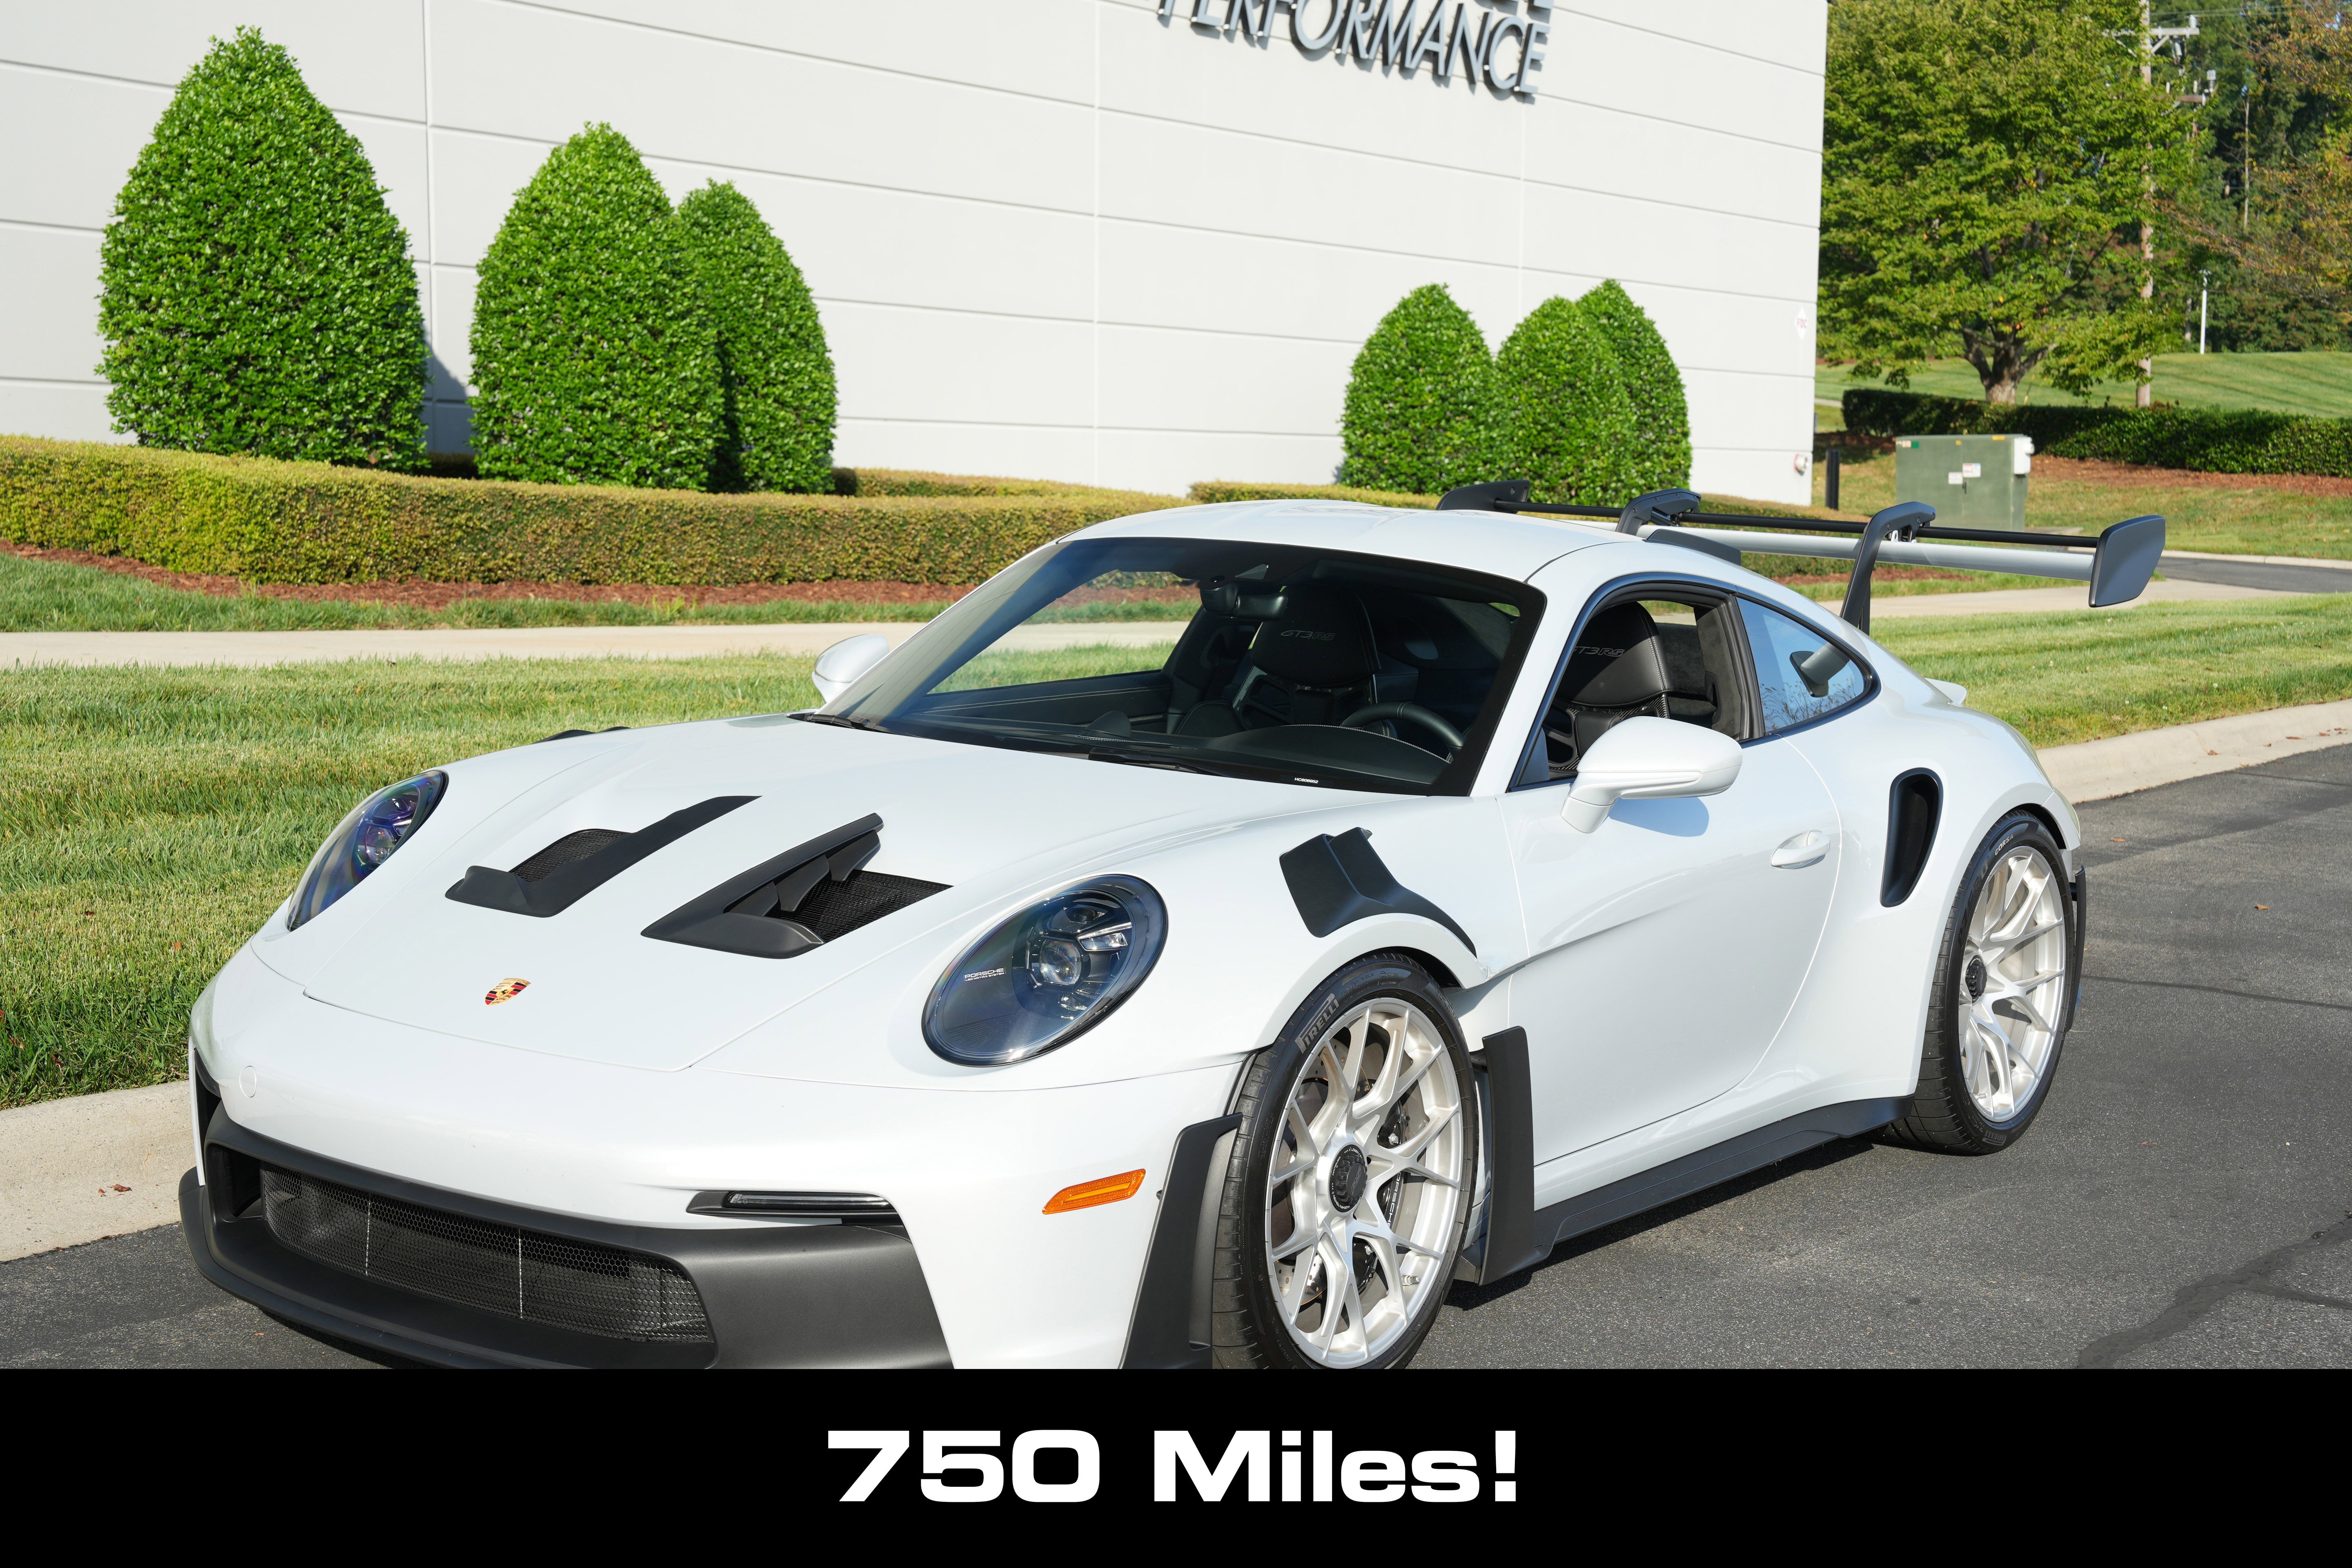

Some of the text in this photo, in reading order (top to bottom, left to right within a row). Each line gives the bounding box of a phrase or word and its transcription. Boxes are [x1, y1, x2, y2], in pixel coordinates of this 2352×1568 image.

[1158, 0, 1551, 94] ORMANCE
[1995, 833, 2014, 856] CORSA
[964, 967, 1004, 979] PORSCHE
[1295, 993, 1340, 1054] PIRELLI
